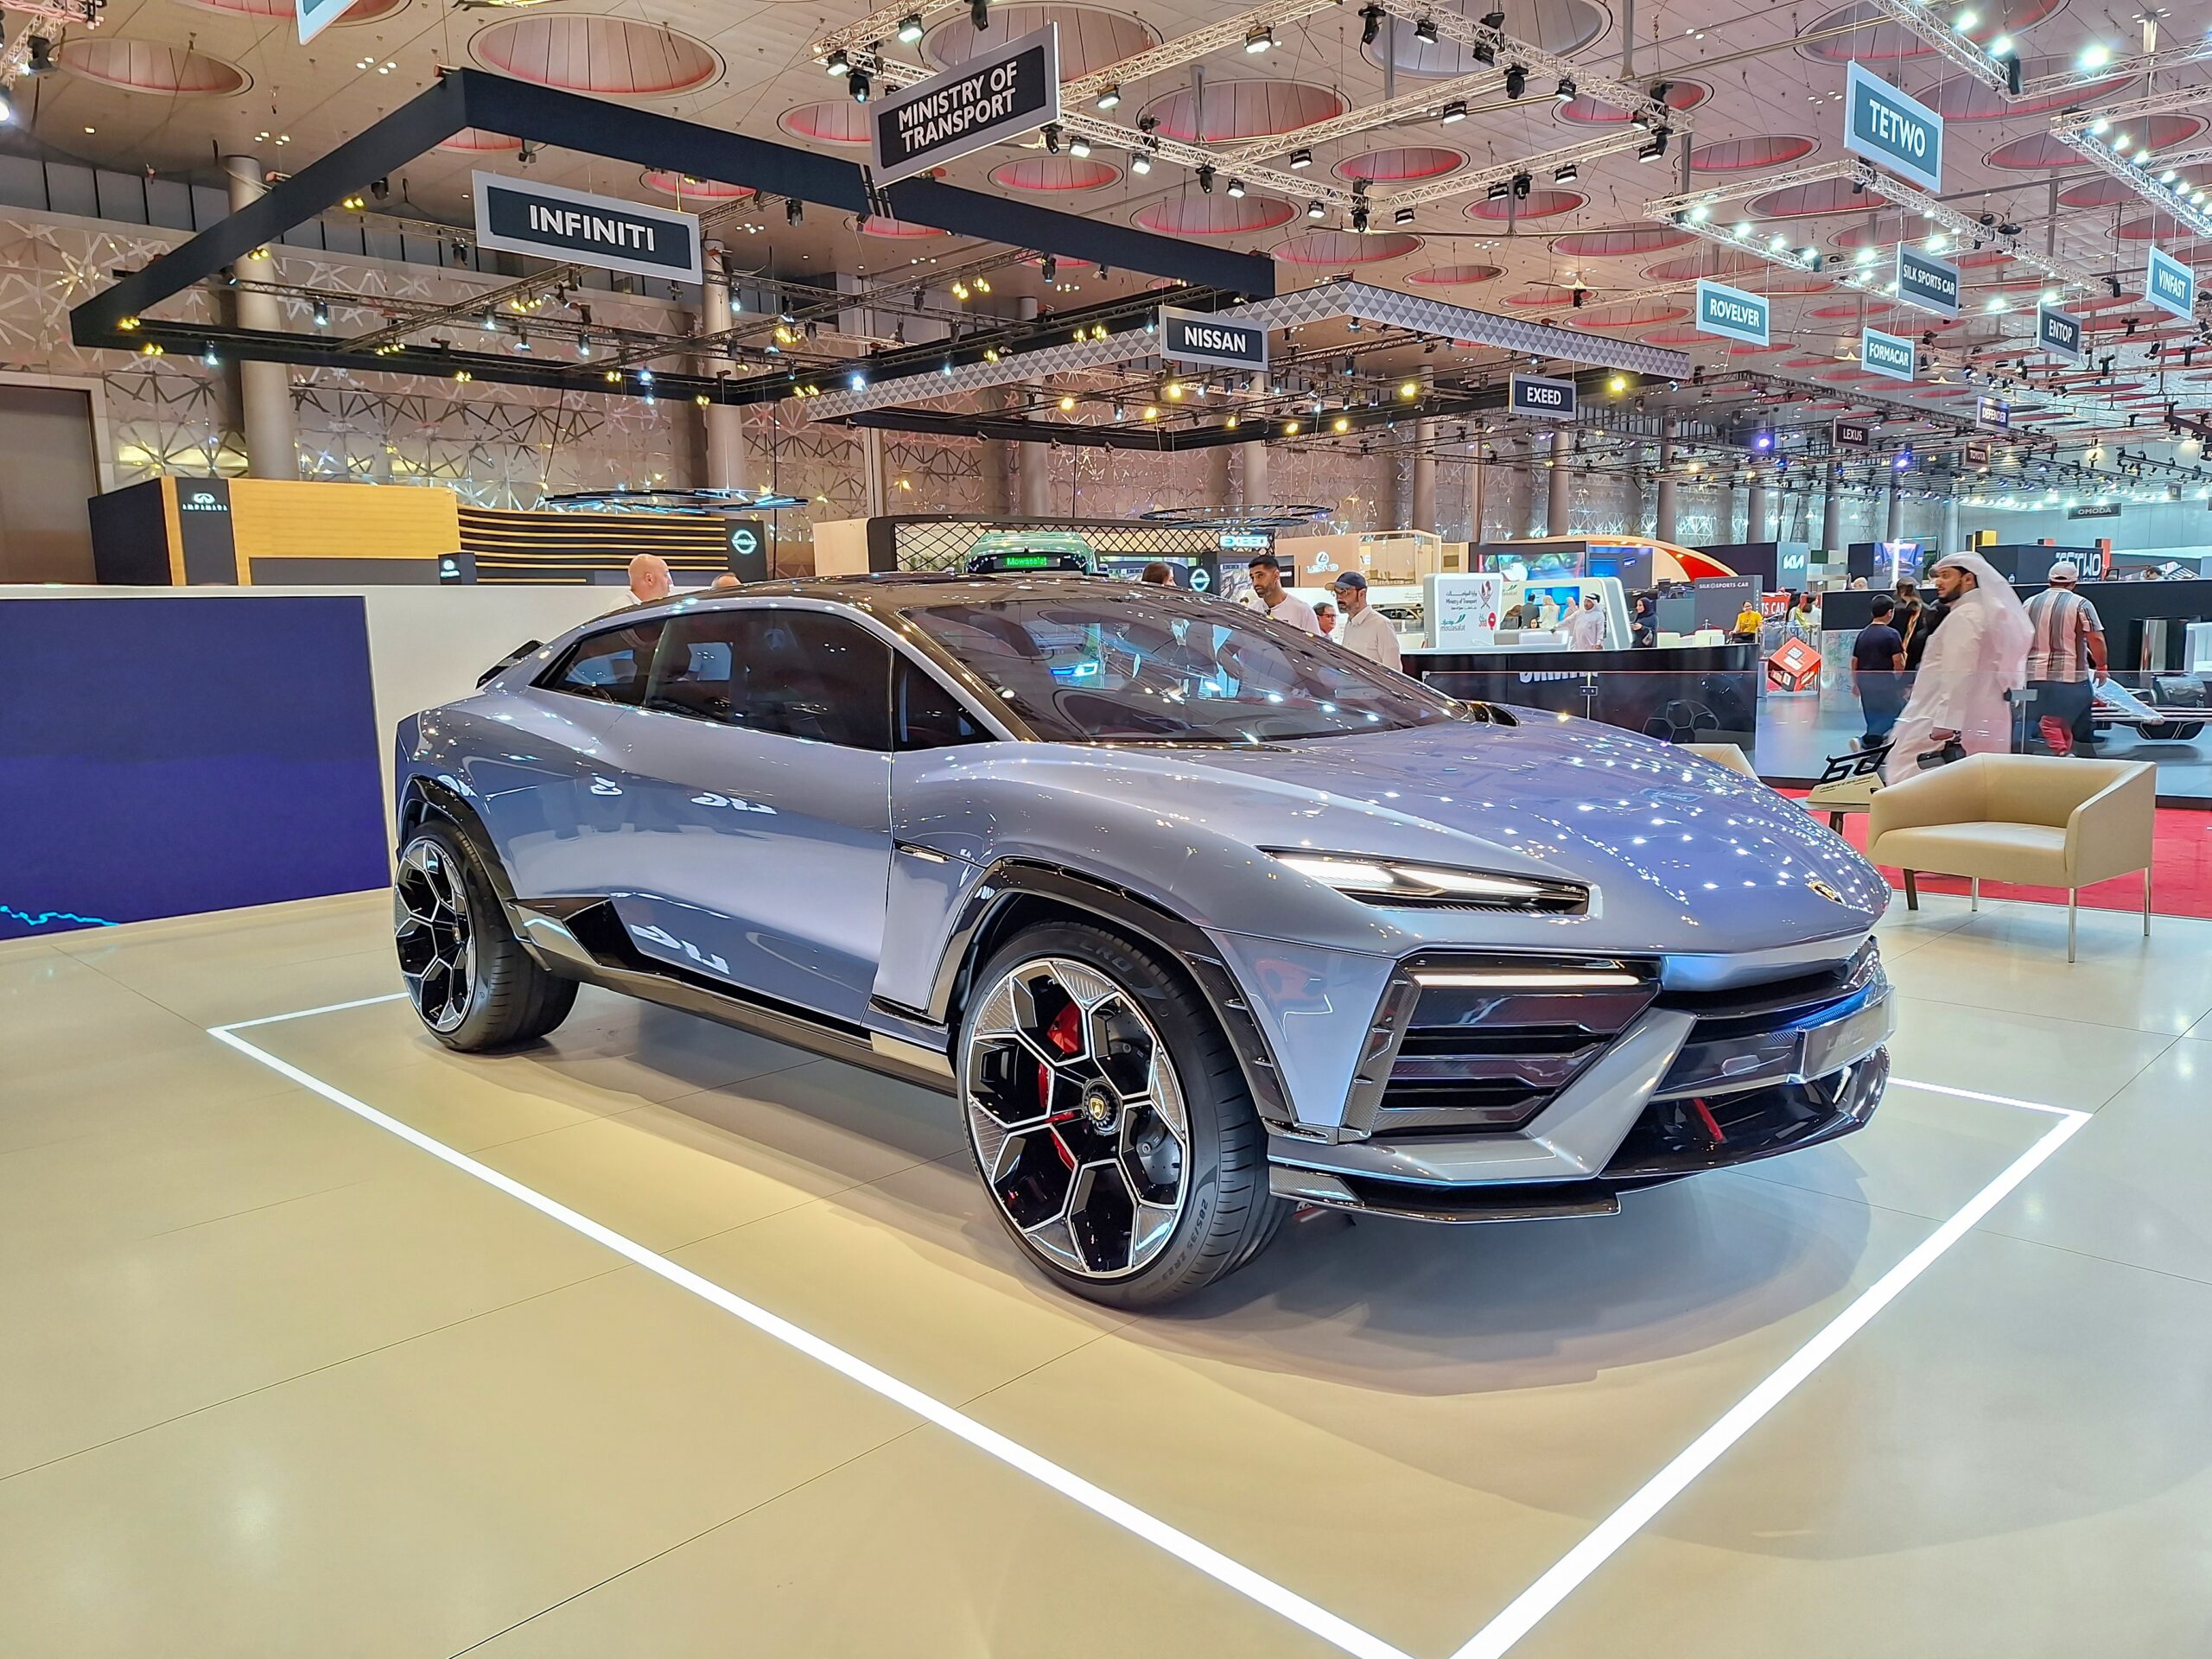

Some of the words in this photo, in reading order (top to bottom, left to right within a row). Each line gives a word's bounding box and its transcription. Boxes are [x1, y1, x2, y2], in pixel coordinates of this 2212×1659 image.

[898, 75, 985, 131] MINISTRY
[989, 61, 1017, 92] OF
[901, 88, 1016, 153] TRANSPORT
[1869, 99, 1926, 157] TETWO
[529, 204, 655, 251] INFINITI
[1904, 264, 1917, 282] SILK
[1918, 269, 1942, 291] SPORTS
[1942, 279, 1955, 296] CAR
[2159, 269, 2186, 300] VINFAST
[1710, 298, 1760, 327] ROVELVER
[1185, 326, 1246, 353] NISSAN
[2049, 319, 2073, 344] ENTOP
[1869, 342, 1910, 367] FORMACAR
[1527, 386, 1562, 405] EXEED
[1982, 407, 2006, 423] DEFENDER
[1843, 427, 1863, 442] LEXUS
[1969, 449, 1986, 461] TOYOTA
[2077, 506, 2113, 516] OMODA
[1821, 738, 1897, 784] 60
